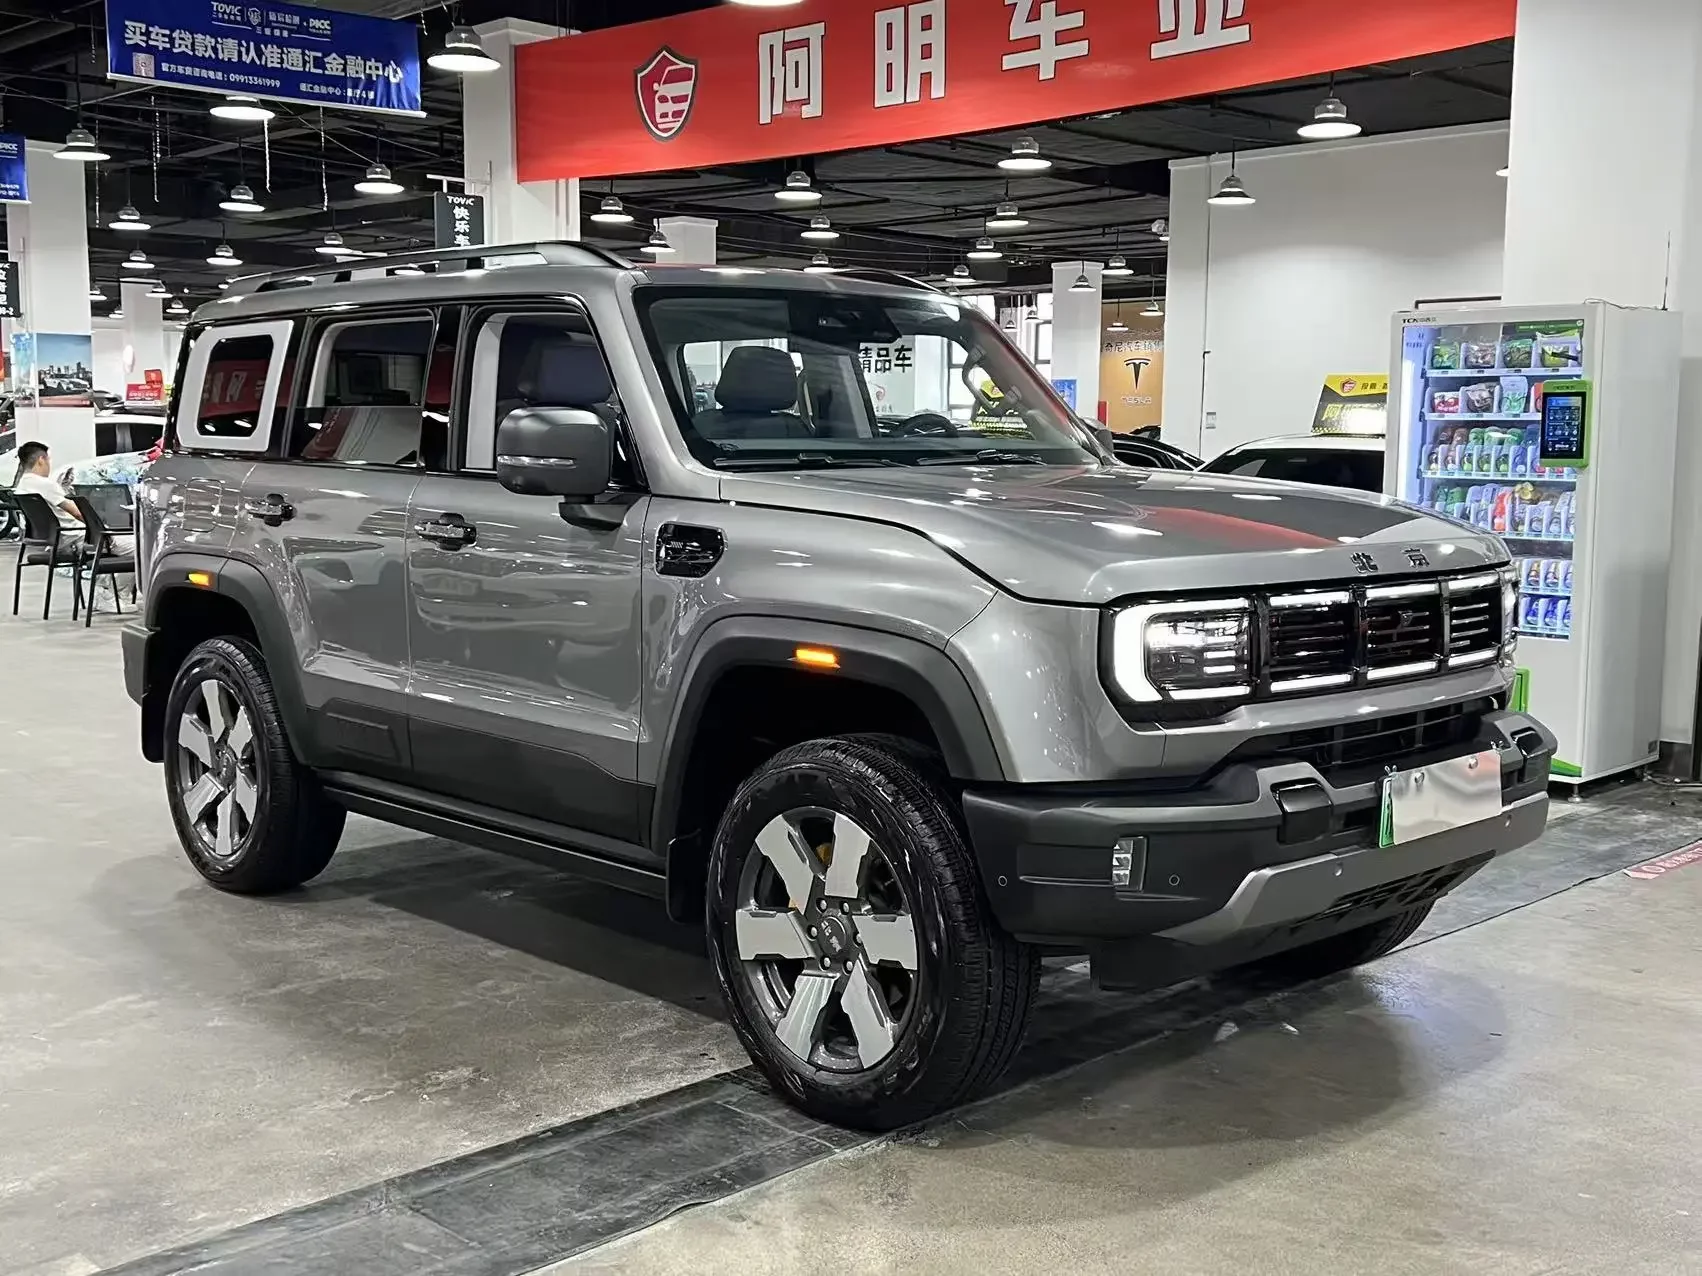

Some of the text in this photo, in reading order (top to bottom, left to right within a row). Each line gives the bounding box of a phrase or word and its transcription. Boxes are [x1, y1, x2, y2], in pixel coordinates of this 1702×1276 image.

[211, 1, 242, 15] TOVIC
[309, 18, 331, 29] PICC
[124, 20, 404, 83] 买车贷款请认准通汇金融中心
[757, 0, 1251, 125] 阿明车业
[447, 196, 475, 206] TOVIC
